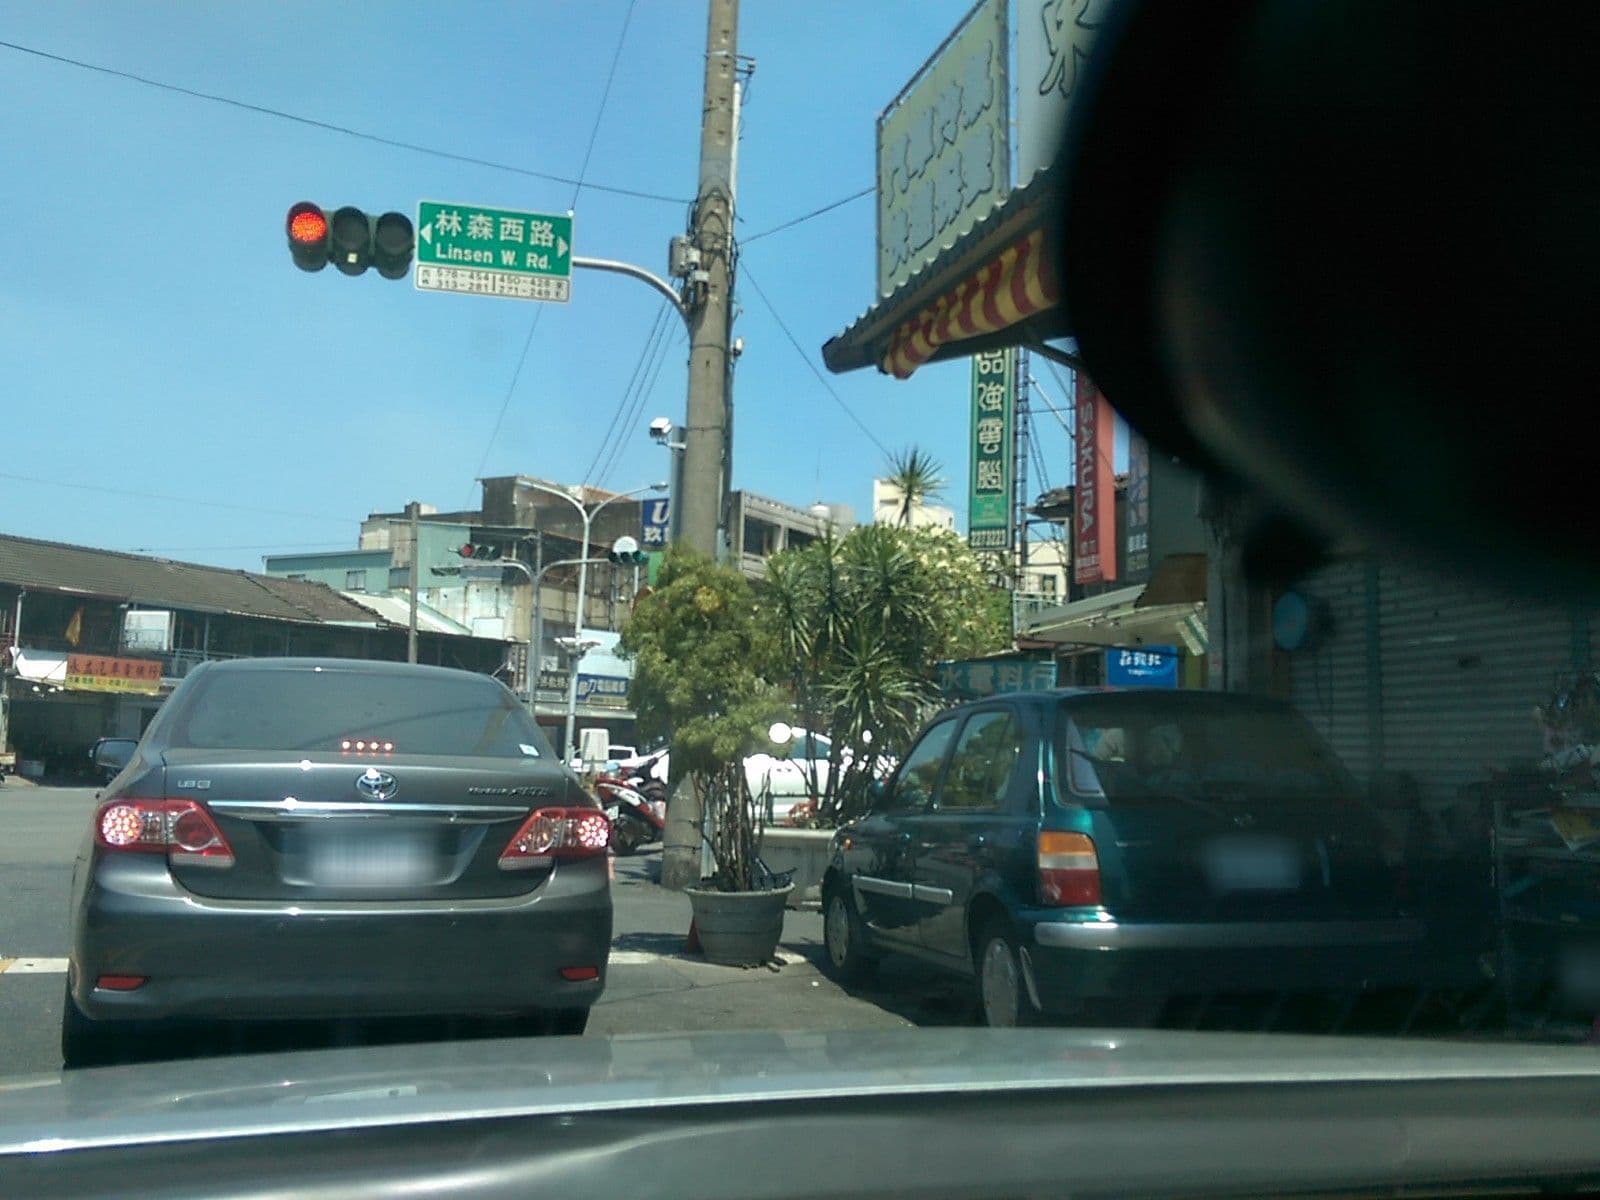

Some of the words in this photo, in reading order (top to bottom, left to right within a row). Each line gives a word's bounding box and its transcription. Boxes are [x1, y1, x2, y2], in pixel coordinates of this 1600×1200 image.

[434, 209, 555, 248] 林森西路
[435, 242, 493, 264] Linsen
[501, 249, 517, 266] W.
[525, 252, 552, 270] Rd.
[1080, 402, 1095, 534] SAKURA
[644, 527, 669, 542] 玖
